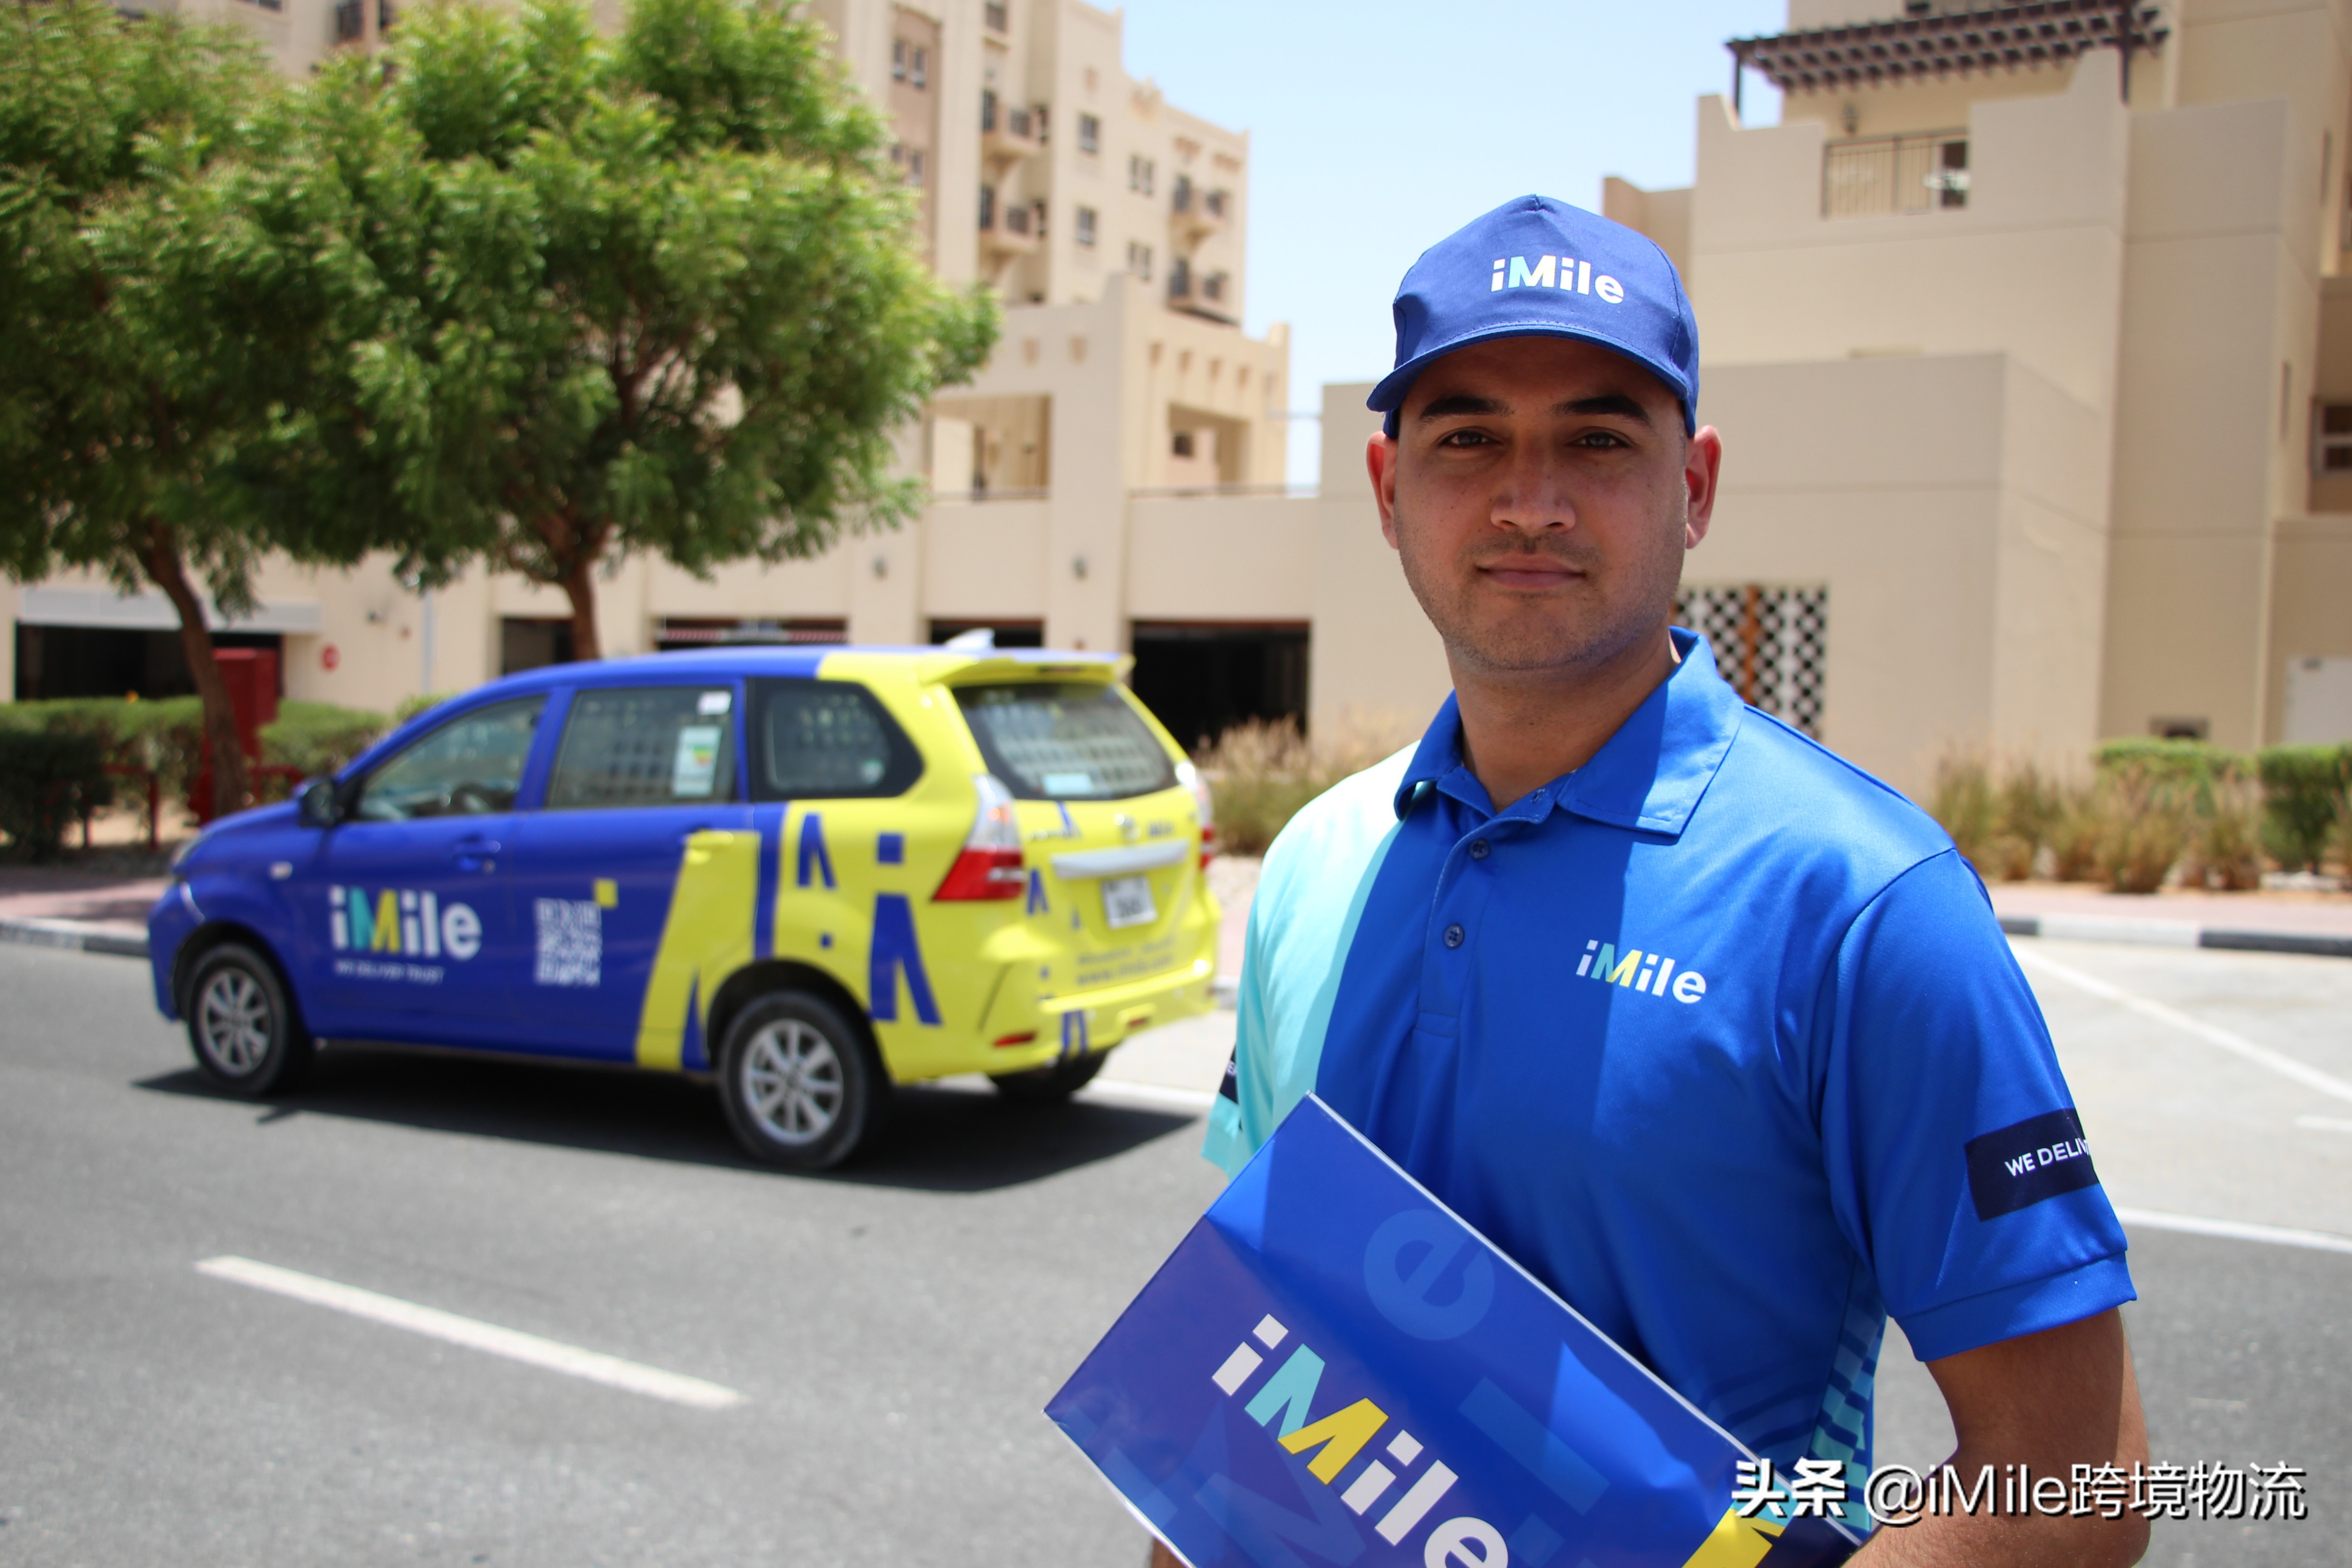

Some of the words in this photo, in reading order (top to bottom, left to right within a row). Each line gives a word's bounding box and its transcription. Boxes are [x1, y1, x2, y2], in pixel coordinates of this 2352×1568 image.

[1491, 255, 1624, 304] iMile
[330, 885, 482, 960] iMile
[1576, 939, 1706, 1004] iMile
[2004, 1152, 2036, 1176] WE
[1212, 1313, 1509, 1568] iMile
